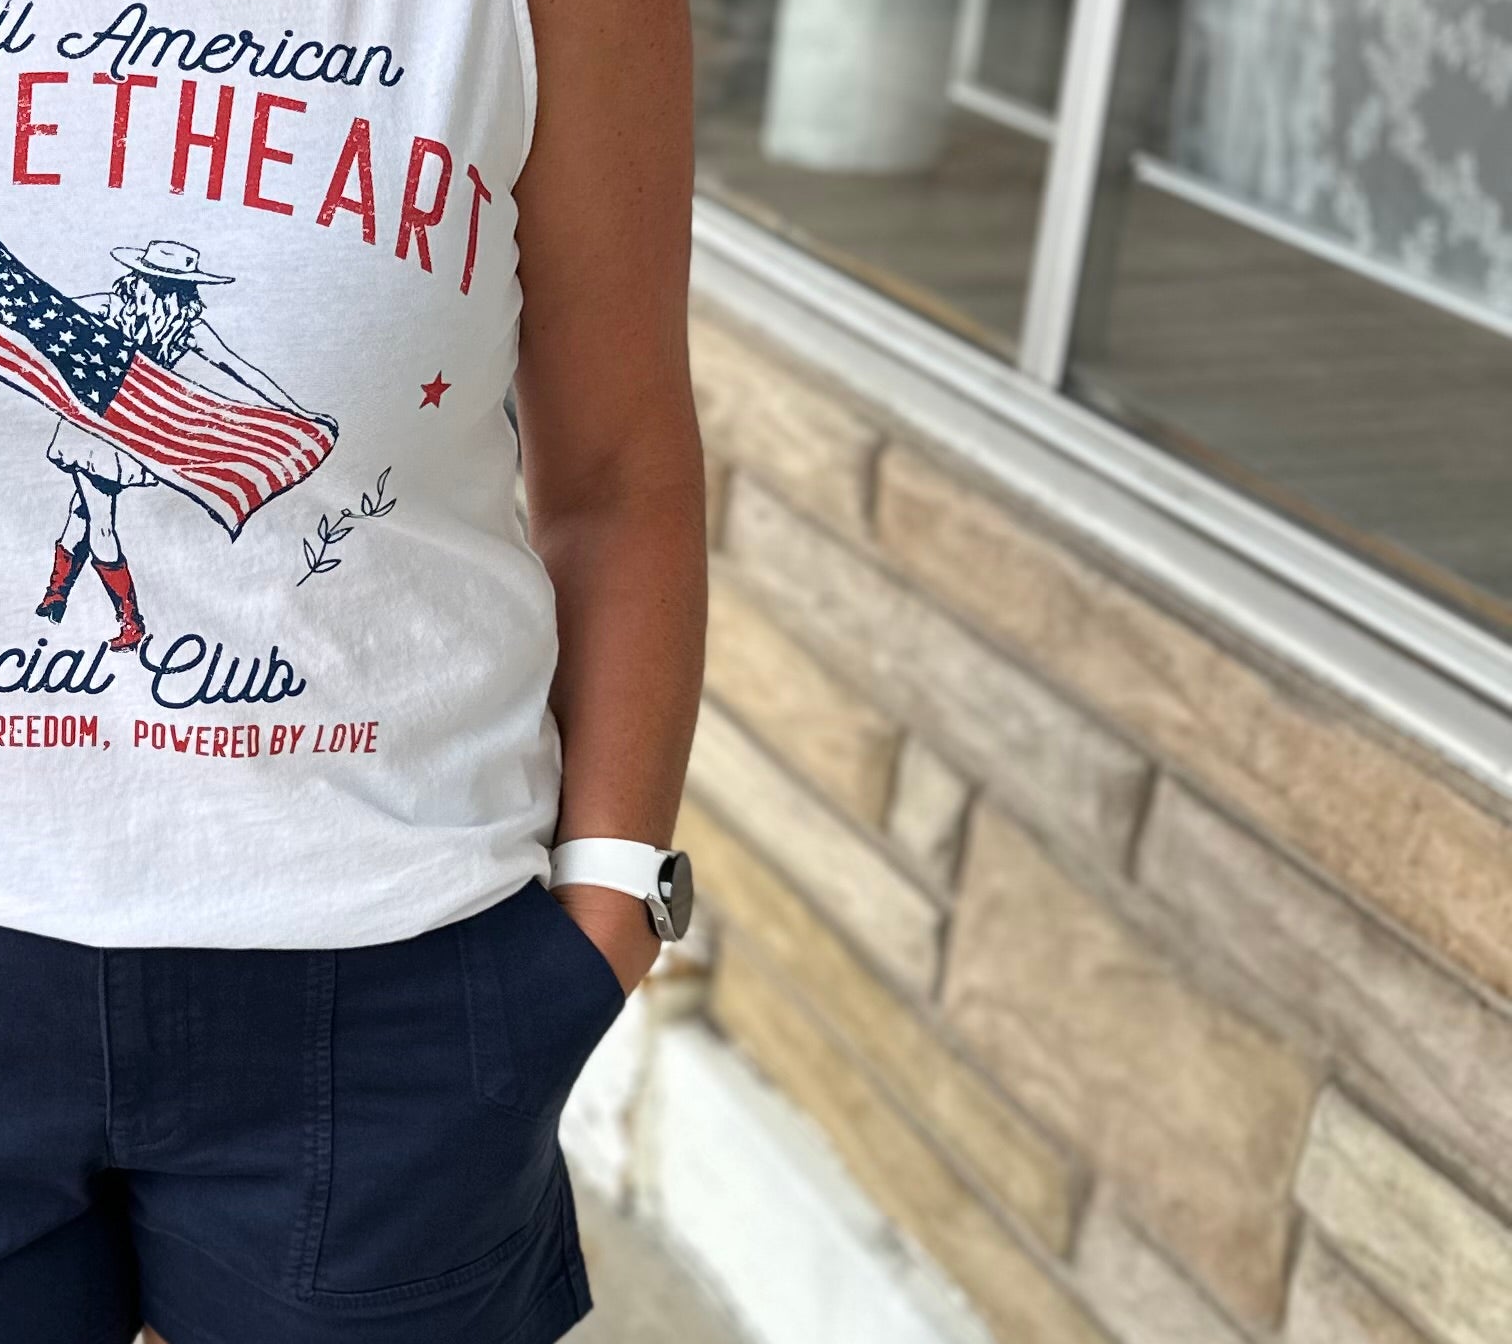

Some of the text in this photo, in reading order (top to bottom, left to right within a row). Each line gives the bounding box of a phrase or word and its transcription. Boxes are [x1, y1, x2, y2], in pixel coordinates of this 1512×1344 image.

[57, 3, 405, 87] American
[139, 633, 307, 709] Club
[134, 720, 260, 758] POWERED
[269, 723, 307, 754] BY
[313, 721, 380, 753] LOVE
